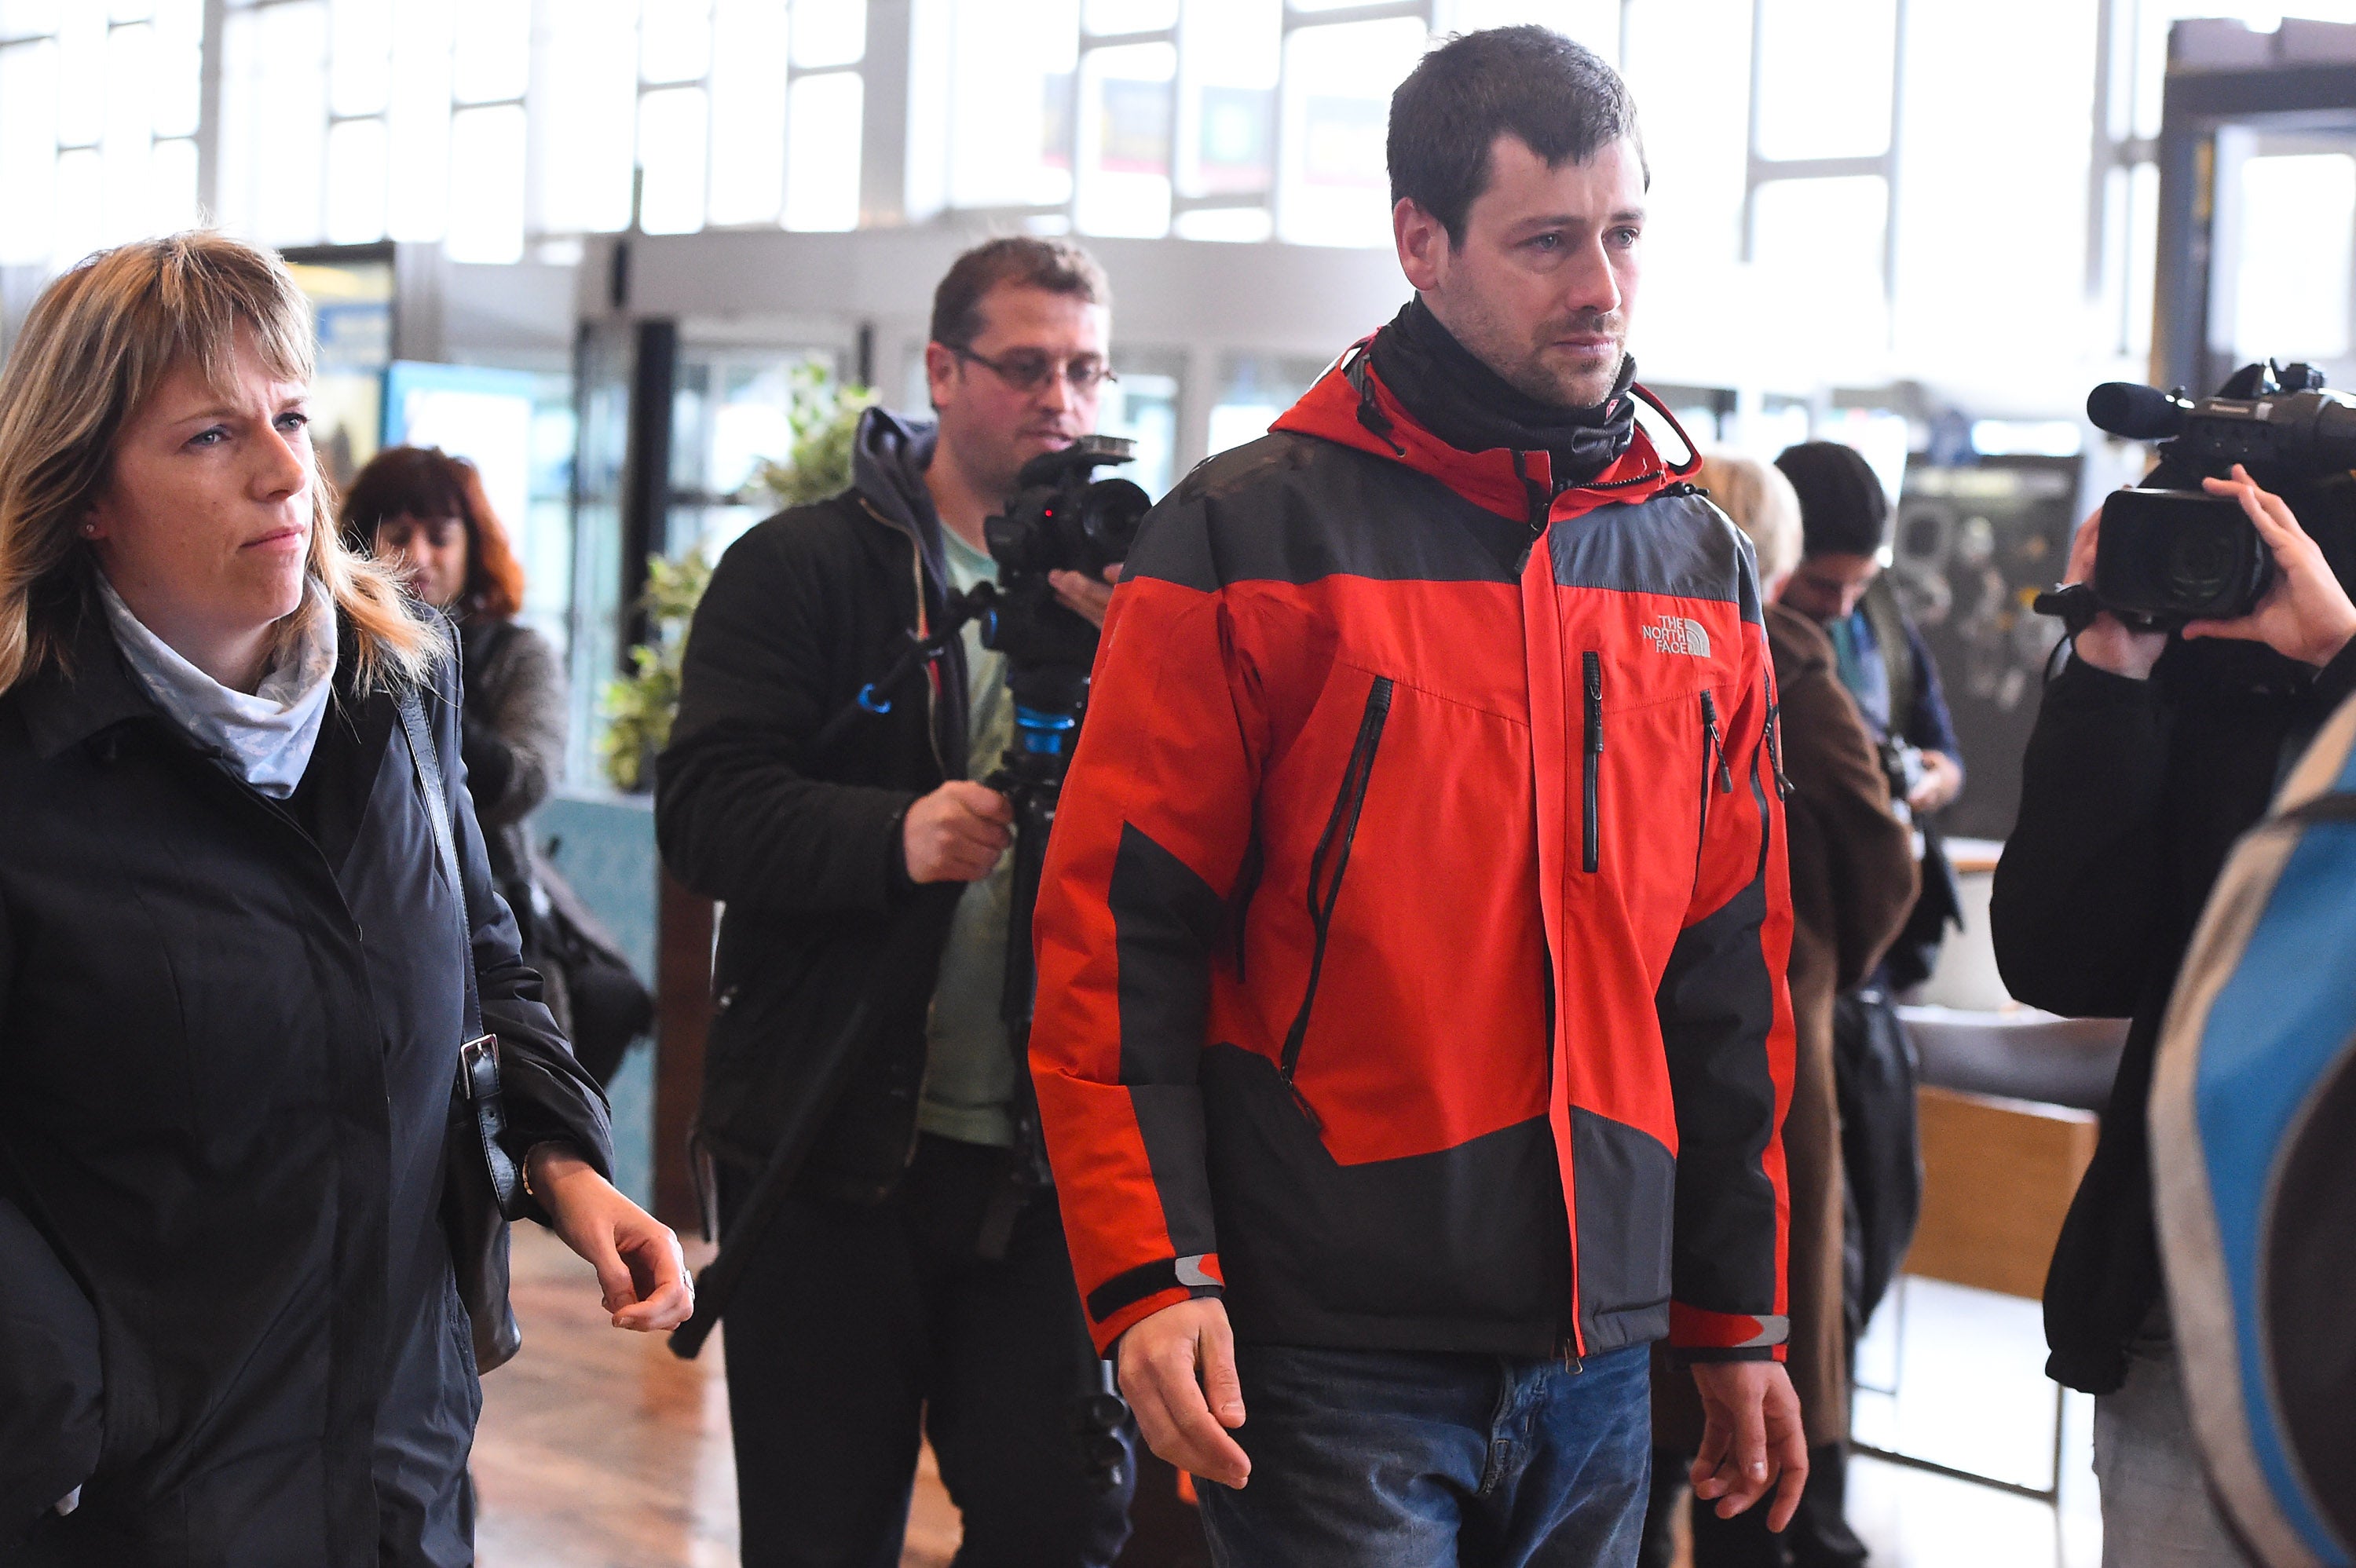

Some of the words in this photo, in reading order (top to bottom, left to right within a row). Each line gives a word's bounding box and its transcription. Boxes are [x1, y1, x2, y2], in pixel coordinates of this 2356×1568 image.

[1659, 615, 1684, 630] THE
[1642, 625, 1686, 642] NORTH
[1655, 640, 1688, 655] FACE
